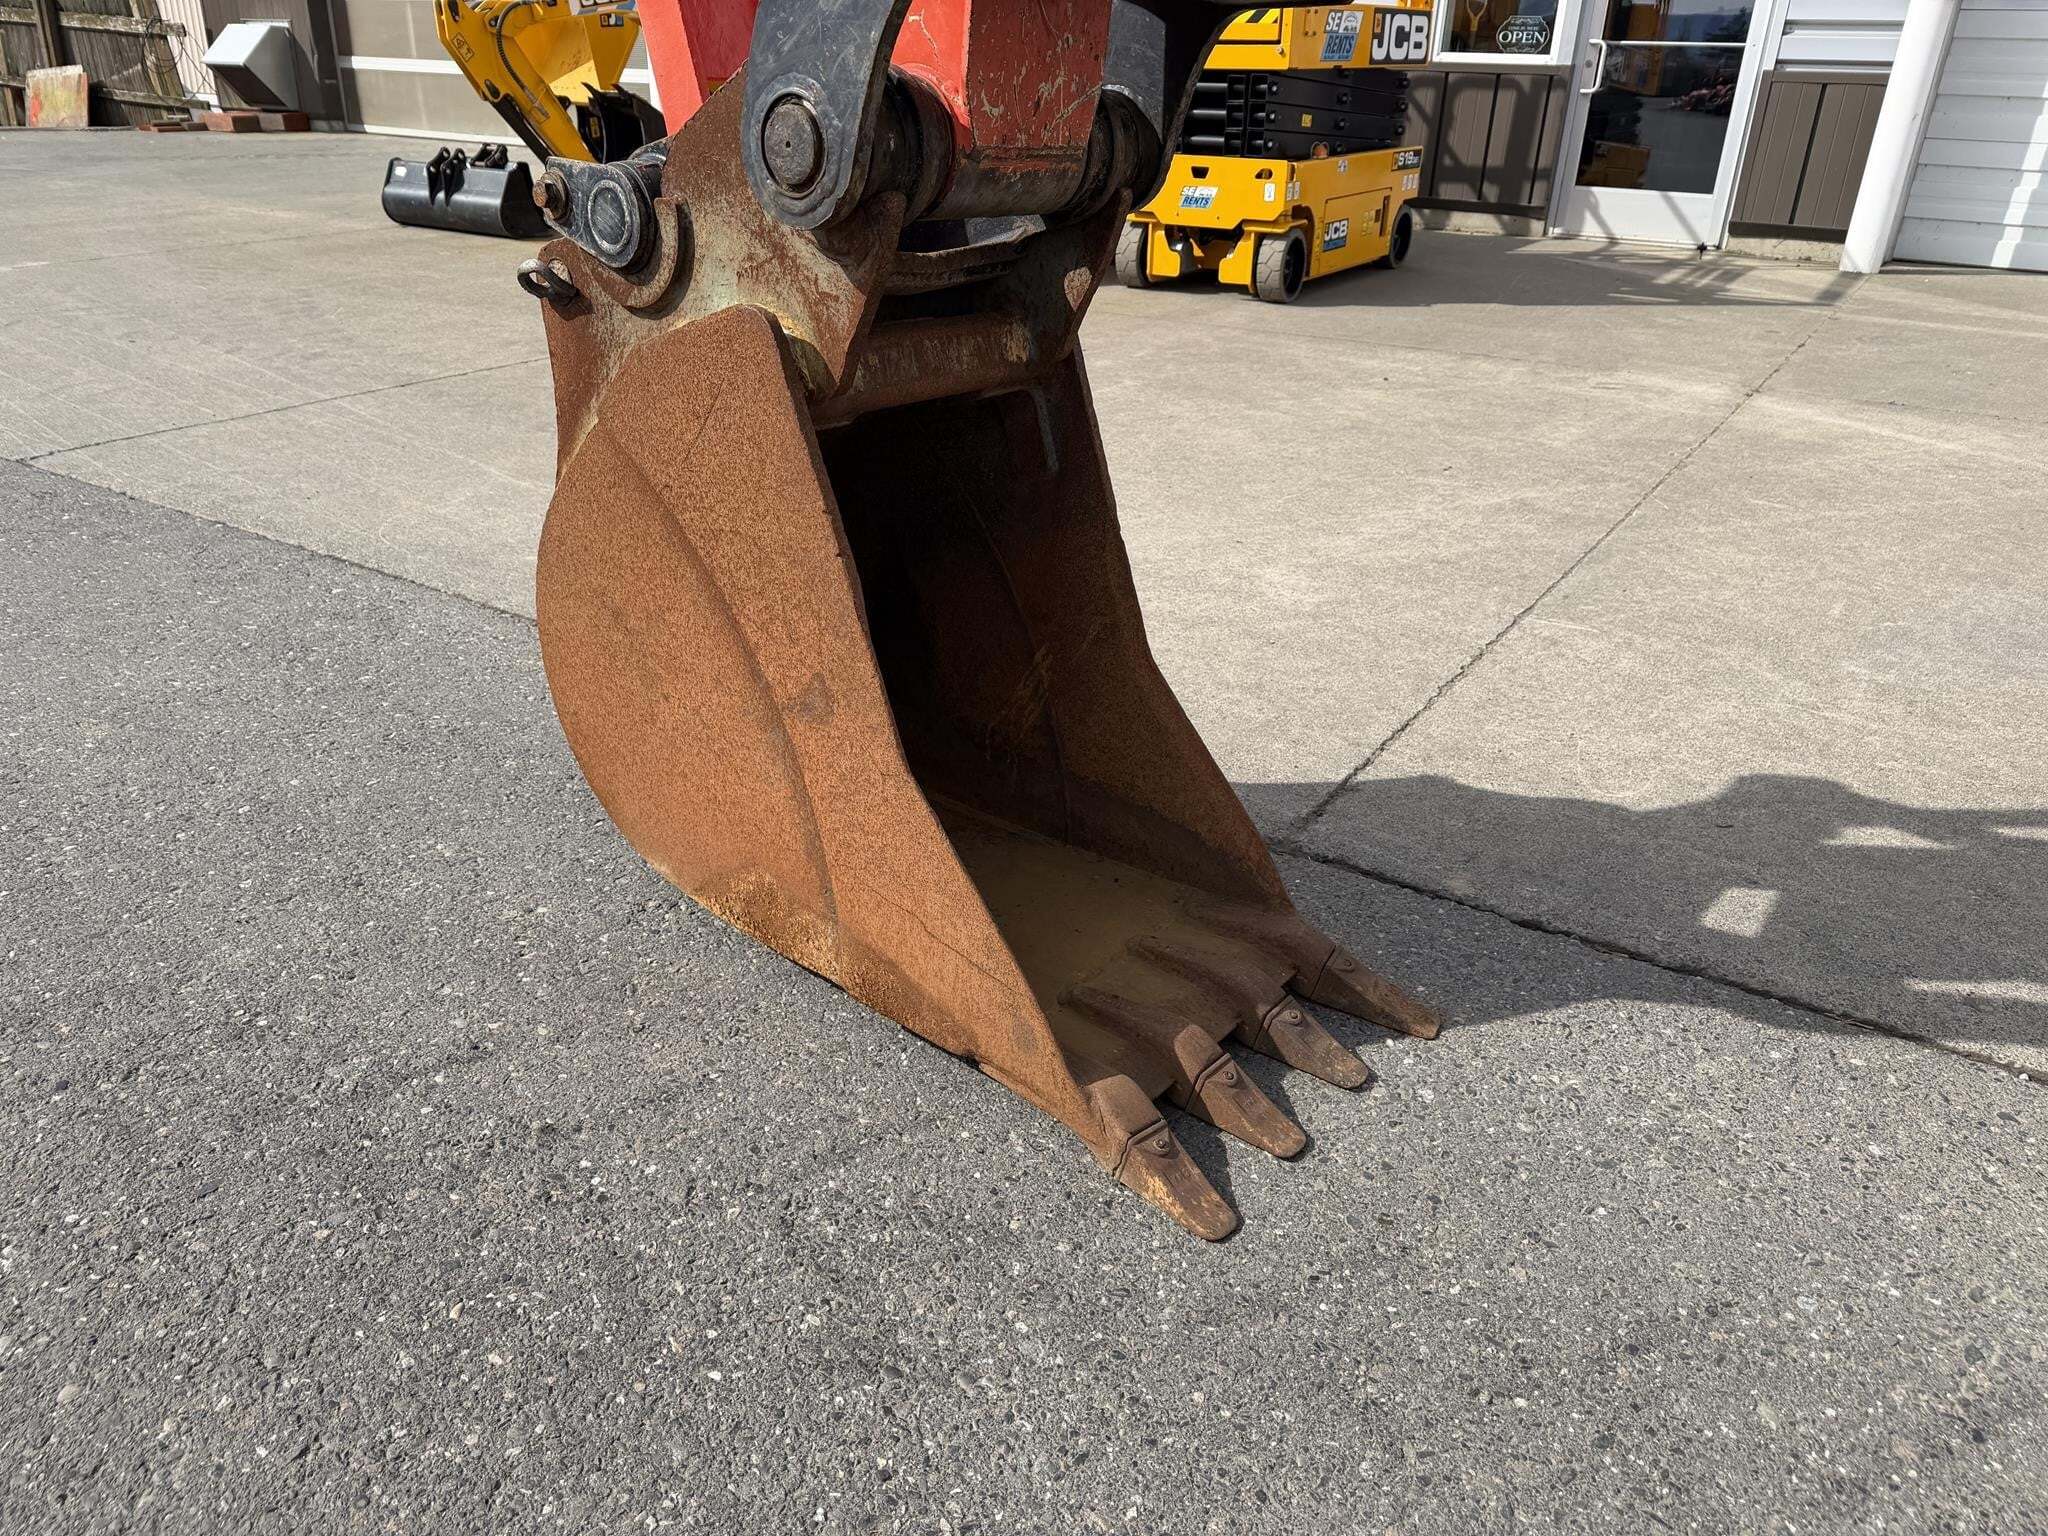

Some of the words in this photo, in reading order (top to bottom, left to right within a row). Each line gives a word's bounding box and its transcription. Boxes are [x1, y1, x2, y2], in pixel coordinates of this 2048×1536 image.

[1325, 34, 1355, 55] RENTS
[1371, 13, 1429, 60] JCB
[1499, 31, 1546, 44] OPEN
[1182, 197, 1210, 206] RENTS
[1324, 219, 1349, 241] JCB
